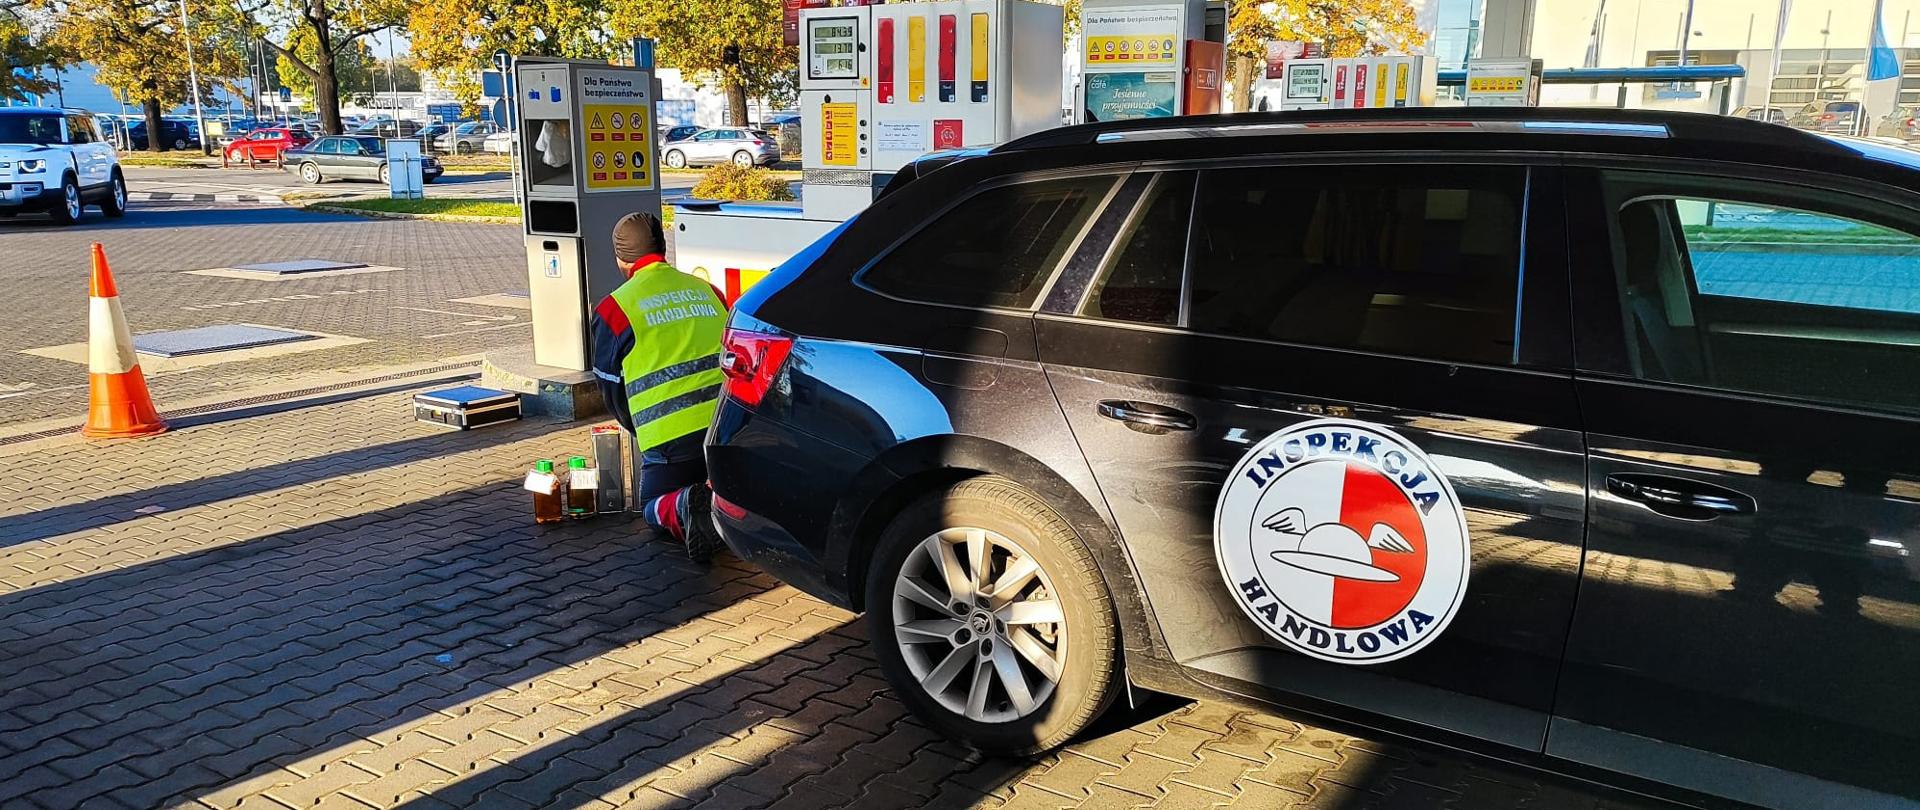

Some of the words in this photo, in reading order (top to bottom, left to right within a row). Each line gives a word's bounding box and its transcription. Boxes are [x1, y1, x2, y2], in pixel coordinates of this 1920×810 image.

[1100, 16, 1126, 24] Państwa
[584, 77, 597, 86] Dla
[600, 77, 632, 87] Państwa
[584, 87, 644, 98] bezpieczeństwa
[1112, 88, 1147, 99] Jesienne
[1101, 98, 1157, 113] przyjemności
[638, 288, 709, 311] INSPEKCJA
[645, 303, 718, 327] HANDLOWA
[1246, 432, 1440, 516] INSPEKCJA
[1239, 576, 1435, 654] HANDLOWA
